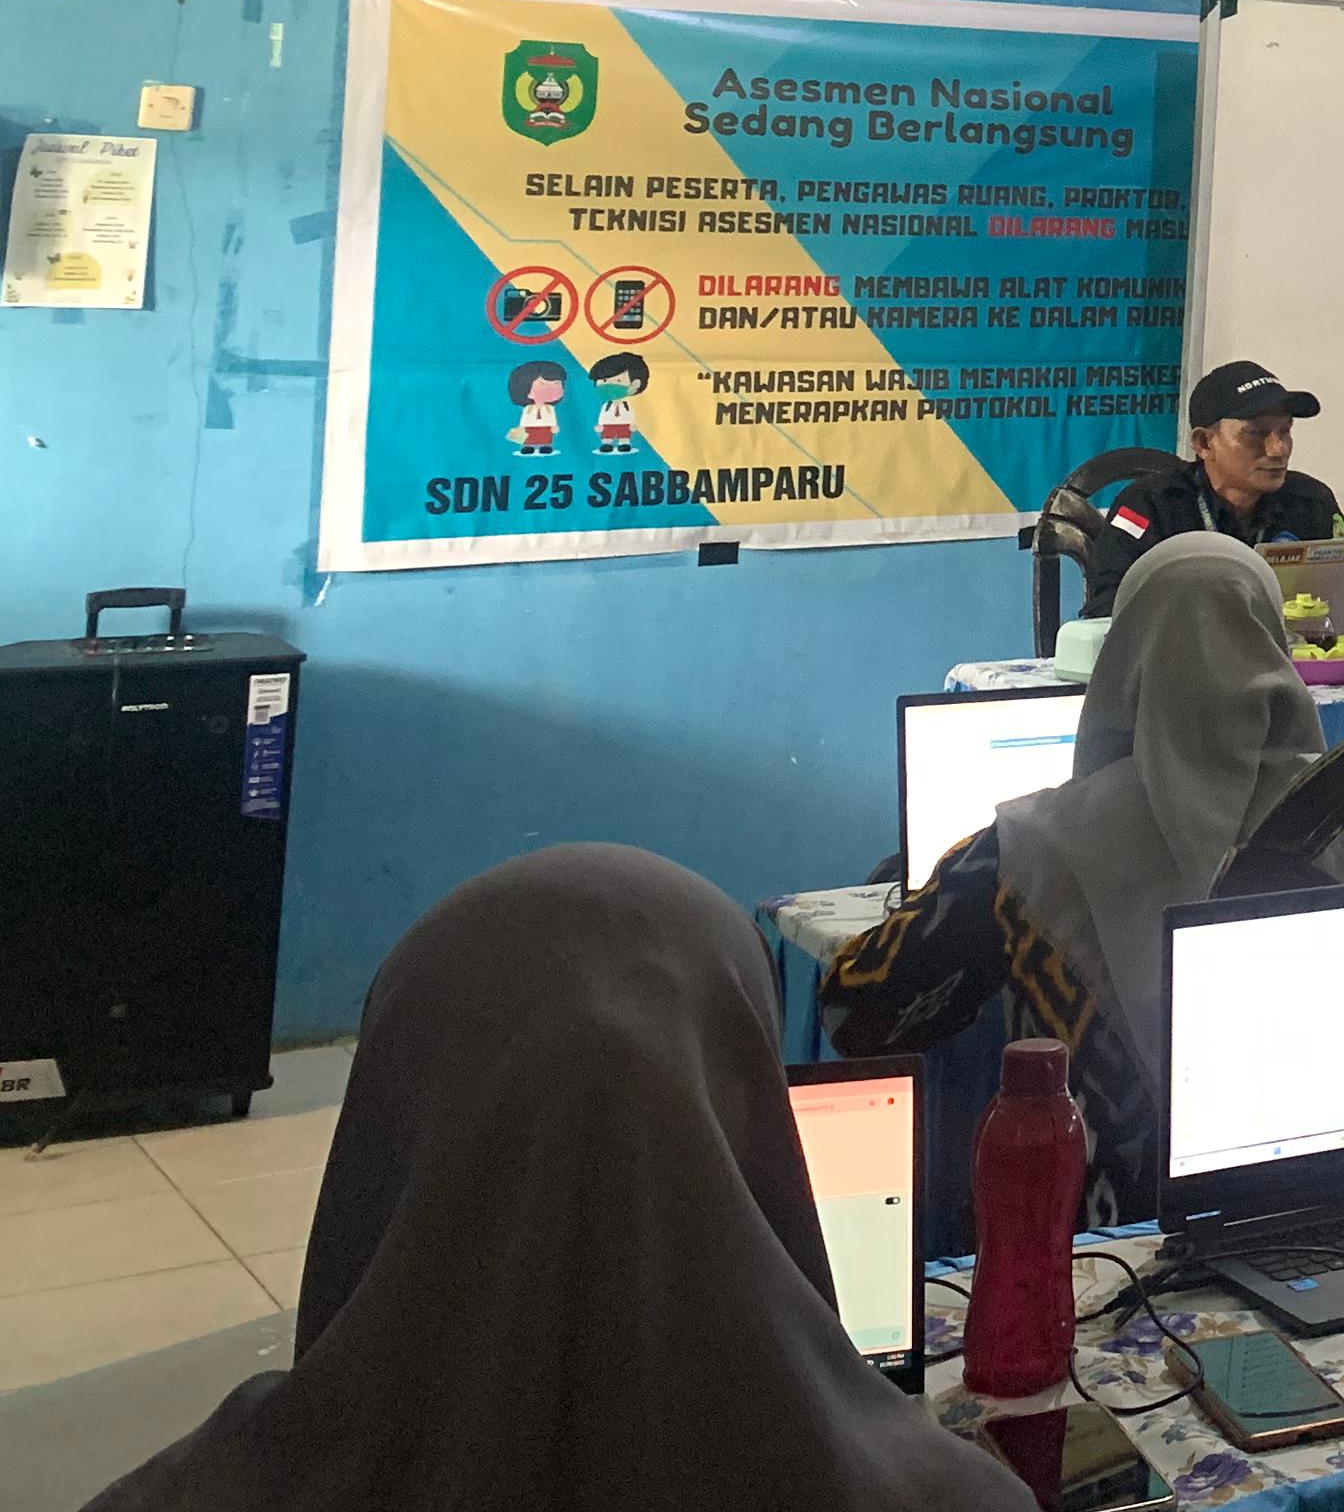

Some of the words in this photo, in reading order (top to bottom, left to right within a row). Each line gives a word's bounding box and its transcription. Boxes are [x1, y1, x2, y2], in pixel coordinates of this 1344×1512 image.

[712, 67, 916, 106] Asesmen
[931, 78, 1113, 116] Nasional
[684, 103, 853, 148] Sedang
[868, 111, 1133, 157] Berlangsung
[526, 173, 634, 198] SELAIN
[646, 176, 786, 203] PESERTA,
[798, 179, 947, 205] PENGAWAS
[958, 184, 1053, 209] RUANG,
[1064, 186, 1185, 210] PROKTOR,
[698, 211, 830, 235] ASESMEN
[842, 214, 978, 237] NASIONAL
[987, 215, 1116, 238] DILARANG
[698, 274, 840, 297] DILARANG
[855, 276, 989, 298] MEMBAWA
[1000, 276, 1068, 298] ALAT
[699, 306, 856, 330] DAN/ATAU
[867, 306, 978, 329] KAMERA
[988, 306, 1021, 329] KE
[1030, 306, 1118, 329] DALAM
[866, 368, 949, 392] WAJIB
[960, 366, 1077, 390] MEMAKAI
[715, 399, 907, 426] MENERAPKAN
[917, 396, 1057, 421] PROTOKOL
[425, 476, 510, 515] SDN
[524, 474, 574, 510] 25
[587, 464, 845, 508] SABBAMPARU
